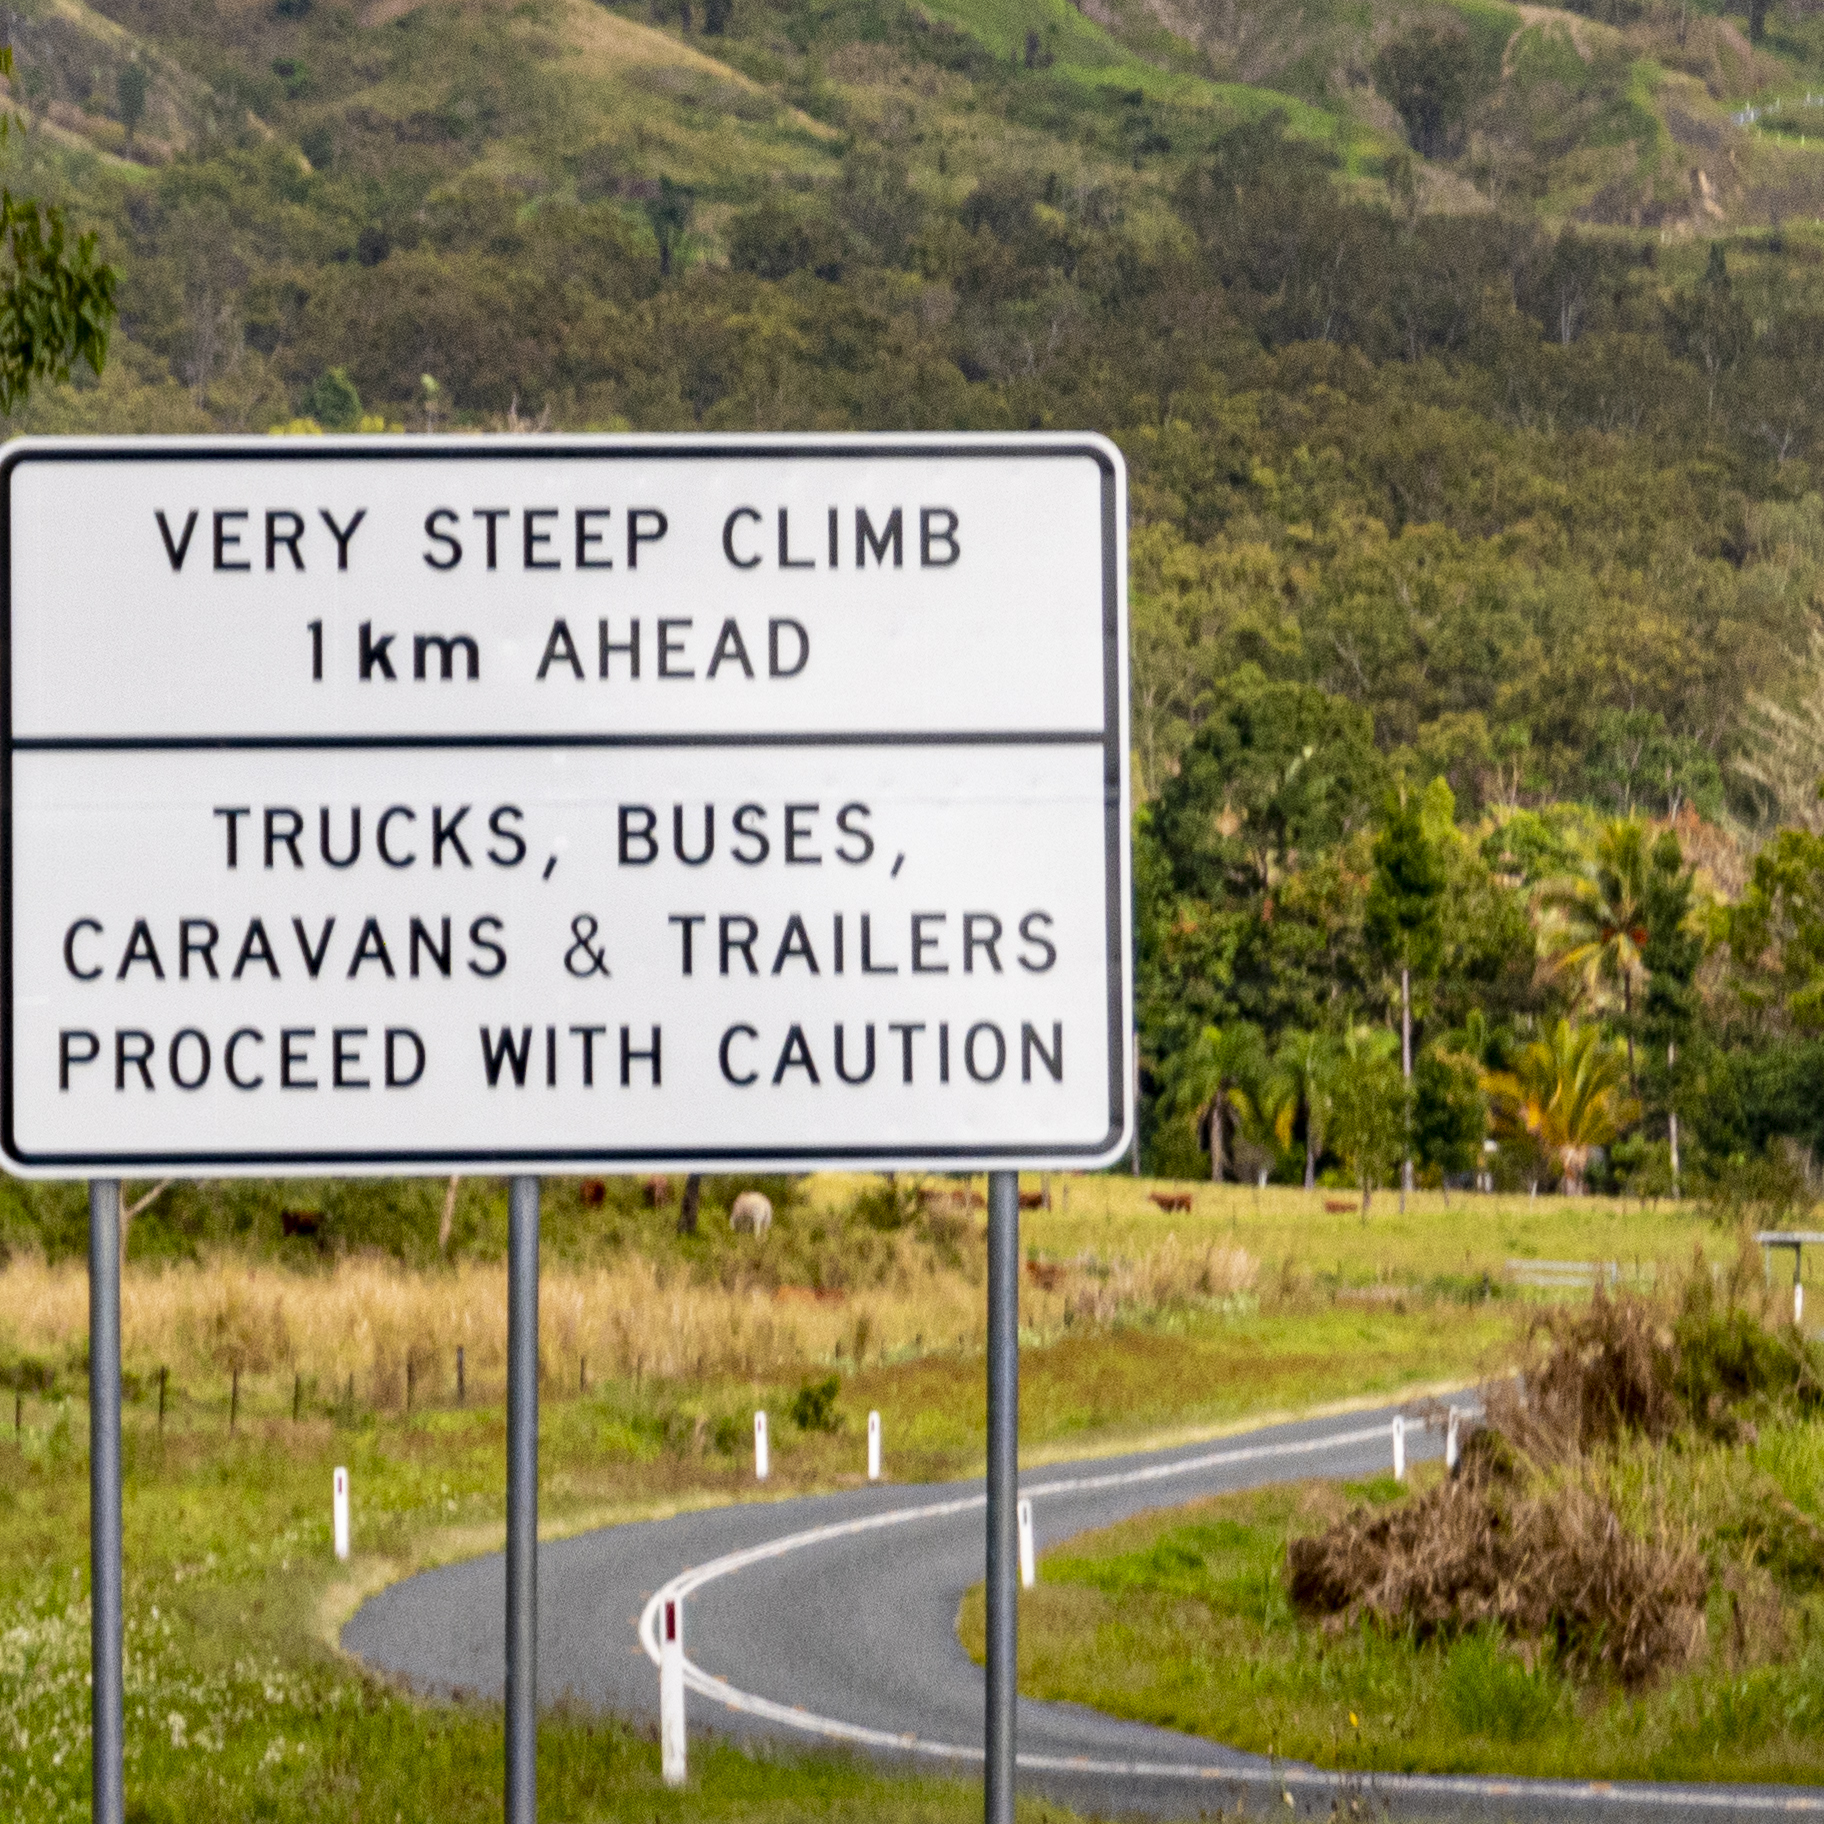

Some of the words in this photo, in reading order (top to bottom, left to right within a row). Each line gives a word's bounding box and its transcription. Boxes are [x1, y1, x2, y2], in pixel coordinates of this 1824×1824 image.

[154, 509, 366, 572] VERY
[423, 508, 669, 571] STEEP
[722, 507, 962, 569] CLIMB
[536, 618, 811, 679] AHEAD
[213, 805, 559, 881] TRUCKS,
[618, 803, 907, 878] BUSES,
[63, 915, 508, 982] CARAVANS
[563, 914, 611, 979] &
[668, 912, 1058, 977] TRAILERS
[59, 1028, 427, 1092] PROCEED
[479, 1025, 663, 1088] WITH
[718, 1022, 1065, 1087] CAUTION
